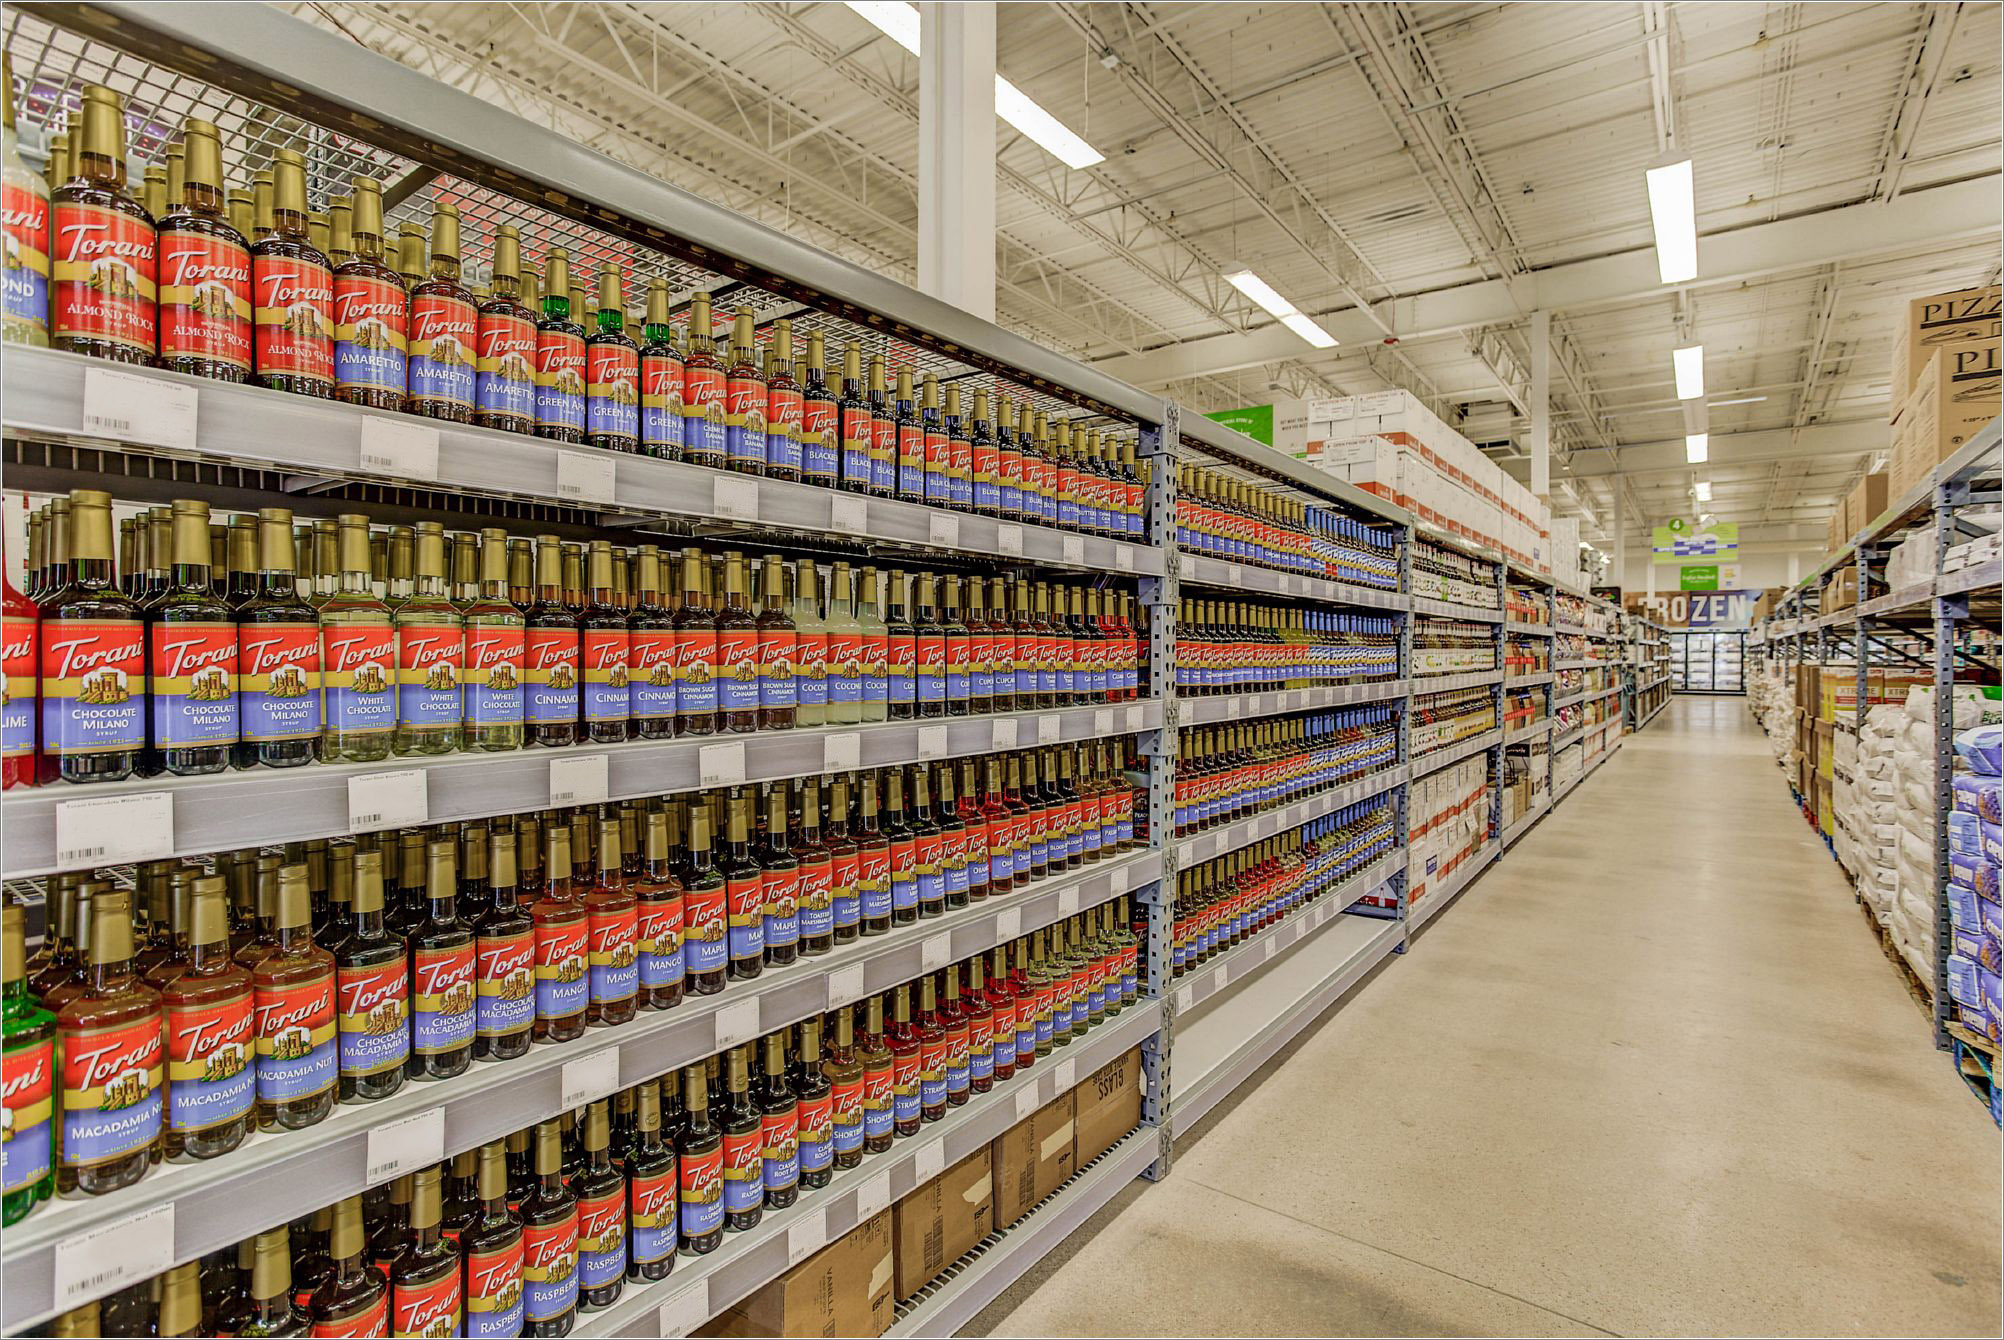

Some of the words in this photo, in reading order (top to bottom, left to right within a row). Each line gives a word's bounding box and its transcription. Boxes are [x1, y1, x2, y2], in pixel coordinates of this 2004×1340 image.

[61, 224, 154, 262] Torani
[168, 251, 248, 287] Torani
[262, 274, 333, 308] Torani
[67, 303, 123, 320] ALMOND
[337, 291, 404, 326] Torani
[1920, 294, 2002, 323] PIZZ
[173, 325, 222, 340] ALMOND
[415, 309, 476, 341] Torani
[268, 345, 312, 358] ALMOND
[341, 352, 402, 371] AMARETTO
[538, 345, 585, 374] Toran
[416, 366, 472, 386] AMARETTO
[594, 357, 638, 385] Toran
[650, 370, 684, 396] Tora
[485, 382, 535, 401] AMARETTO
[690, 381, 727, 407] Toran
[730, 391, 767, 416] Toran
[537, 395, 569, 409] GREEN
[571, 399, 585, 413] APP
[593, 406, 623, 418] GREEN
[774, 401, 804, 425] Tora
[649, 416, 676, 428] GREEN
[807, 410, 837, 433] Tora
[850, 420, 871, 441] Tor
[877, 465, 895, 476] BLACK
[1673, 520, 1681, 530] 4
[51, 635, 143, 681] Torani
[163, 637, 238, 679] Torani
[246, 637, 319, 676] Torani
[331, 636, 394, 673] Torani
[407, 636, 463, 671] Torani
[532, 640, 578, 671] Toran
[592, 640, 629, 671] Tora
[634, 641, 675, 670] Toran
[721, 639, 758, 667] Toran
[797, 642, 827, 666] Tora
[830, 641, 862, 666] Tora
[861, 642, 888, 666] Tora
[491, 693, 514, 701] WHITE
[638, 691, 675, 701] CINNAMO
[802, 684, 827, 692] COCON
[835, 682, 862, 690] COCON
[865, 681, 888, 689] COCON
[183, 704, 236, 716] CHOCOLATE
[262, 700, 314, 711] CHOCOLATE
[347, 705, 392, 715] CHOCOLATE
[358, 697, 384, 705] WHITE
[420, 702, 459, 711] CHOCOLATE
[430, 694, 454, 702] WHITE
[482, 701, 521, 709] CHOCOLATE
[535, 694, 578, 705] CINNAMO
[595, 693, 629, 703] CINNAM
[71, 707, 137, 720] CHOCOLATE
[82, 719, 129, 730] MILANO
[193, 714, 231, 725] MILANO
[271, 710, 308, 721] MILANO
[864, 858, 890, 881] Tora
[800, 873, 832, 897] Toran
[735, 887, 762, 916] Tora
[688, 900, 726, 929] Toran
[773, 920, 797, 931] MAPLE
[594, 922, 637, 954] Toran
[701, 944, 725, 957] MAPLE
[480, 945, 535, 984] Toran
[650, 956, 682, 971] MANGO
[418, 957, 476, 999] Toran
[606, 969, 638, 984] MANGO
[341, 973, 408, 1018] Toran
[492, 995, 535, 1011] CHOCOLAT
[552, 983, 587, 999] MANGO
[256, 989, 329, 1039] Torani
[431, 1012, 476, 1027] CHOCOLAT
[481, 1003, 530, 1019] MACADAMIA
[178, 1003, 254, 1064] Torani
[419, 1018, 473, 1036] MACADAMIA
[344, 1036, 403, 1057] MACADAMIA
[75, 1025, 162, 1093] Torani
[257, 1065, 314, 1081] MACADAMIA
[316, 1055, 333, 1070] NUT
[178, 1082, 246, 1108] MACADAMIA
[866, 1077, 894, 1101] Tora
[1098, 1068, 1124, 1101] GLASS
[72, 1109, 151, 1141] MACADAMIA
[803, 1104, 832, 1132] Tora
[763, 1119, 799, 1148] Toran
[730, 1140, 763, 1170] Tora
[687, 1158, 723, 1192] Tora
[774, 1167, 790, 1178] ROOT
[639, 1182, 676, 1217] Tora
[582, 1201, 626, 1241] Tora
[529, 1225, 578, 1269] Toran
[586, 1248, 626, 1272] RASPBERR
[475, 1250, 524, 1299] Toran
[534, 1279, 578, 1303] RASPBERR
[402, 1283, 460, 1335] Torani
[480, 1303, 523, 1334] RASPBERR
